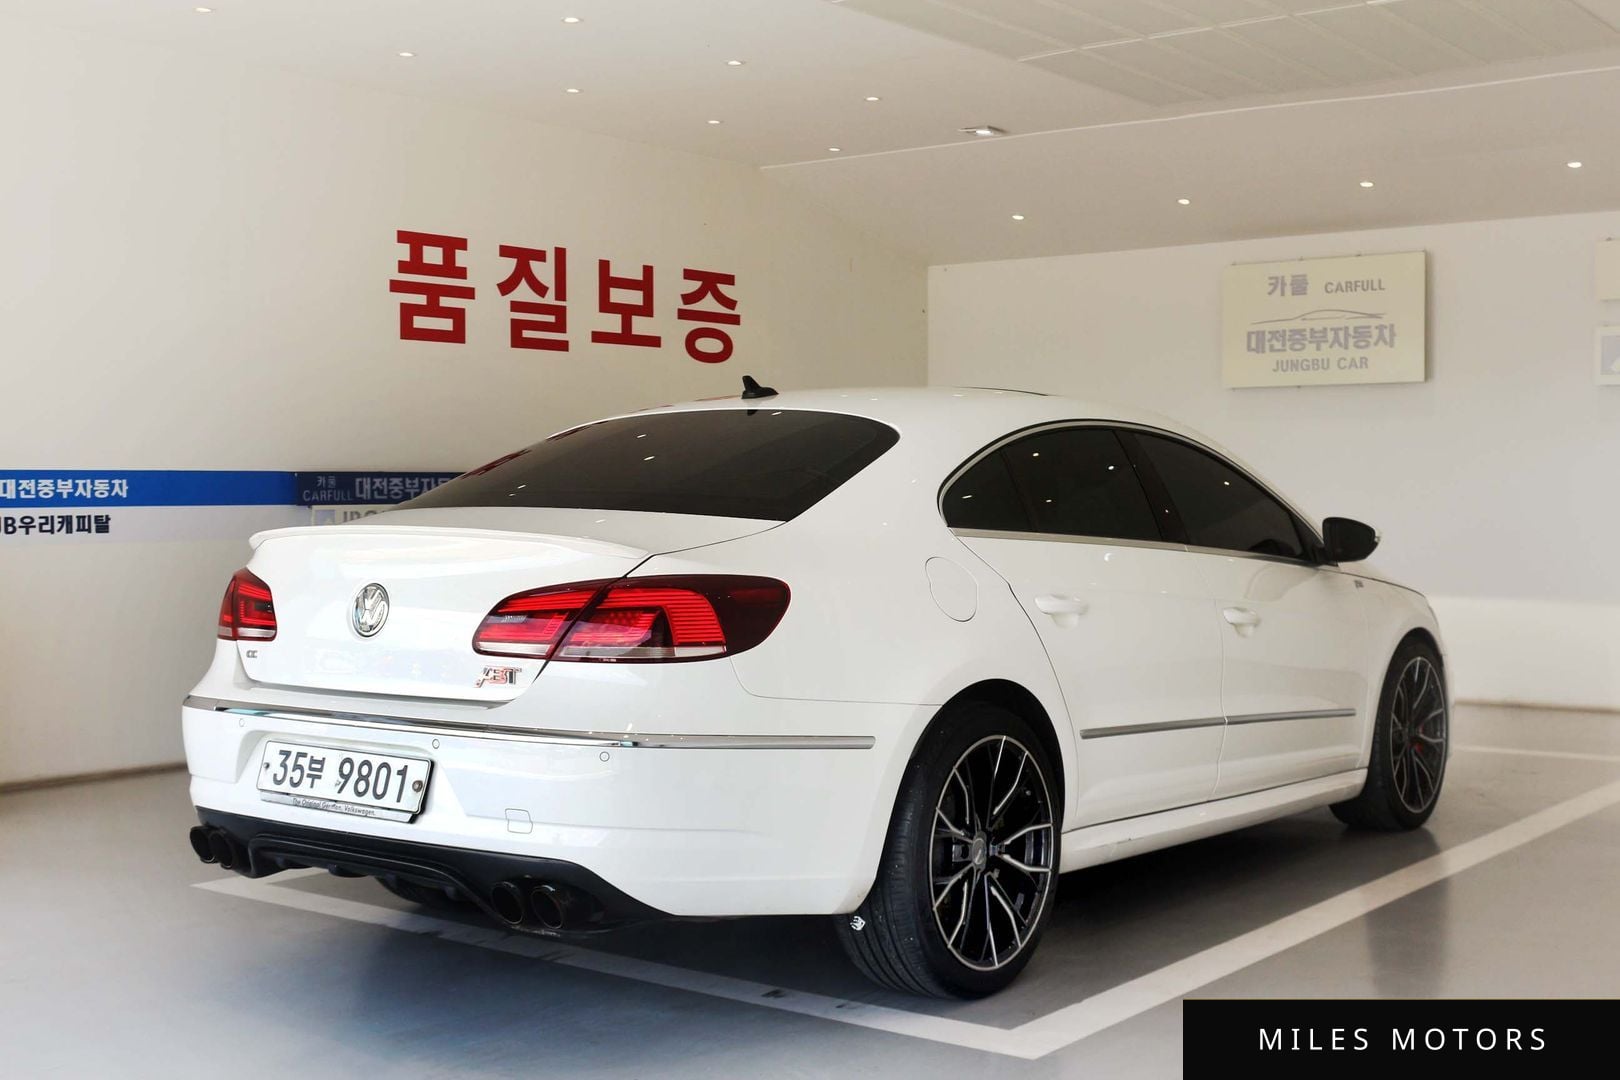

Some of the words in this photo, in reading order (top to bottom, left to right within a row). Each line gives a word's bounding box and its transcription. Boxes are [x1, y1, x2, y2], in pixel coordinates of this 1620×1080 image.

[389, 229, 741, 364] 품질보증
[1324, 279, 1386, 294] CARFULL
[1246, 324, 1397, 354] 대전중부자동차
[1272, 358, 1330, 373] JUNGBU
[1337, 357, 1369, 370] CAR
[0, 479, 128, 499] 대전중부자동차
[302, 490, 350, 502] CARFULL
[0, 515, 111, 535] B우리캐피탈
[272, 750, 326, 789] 35부
[336, 757, 409, 803] 9801
